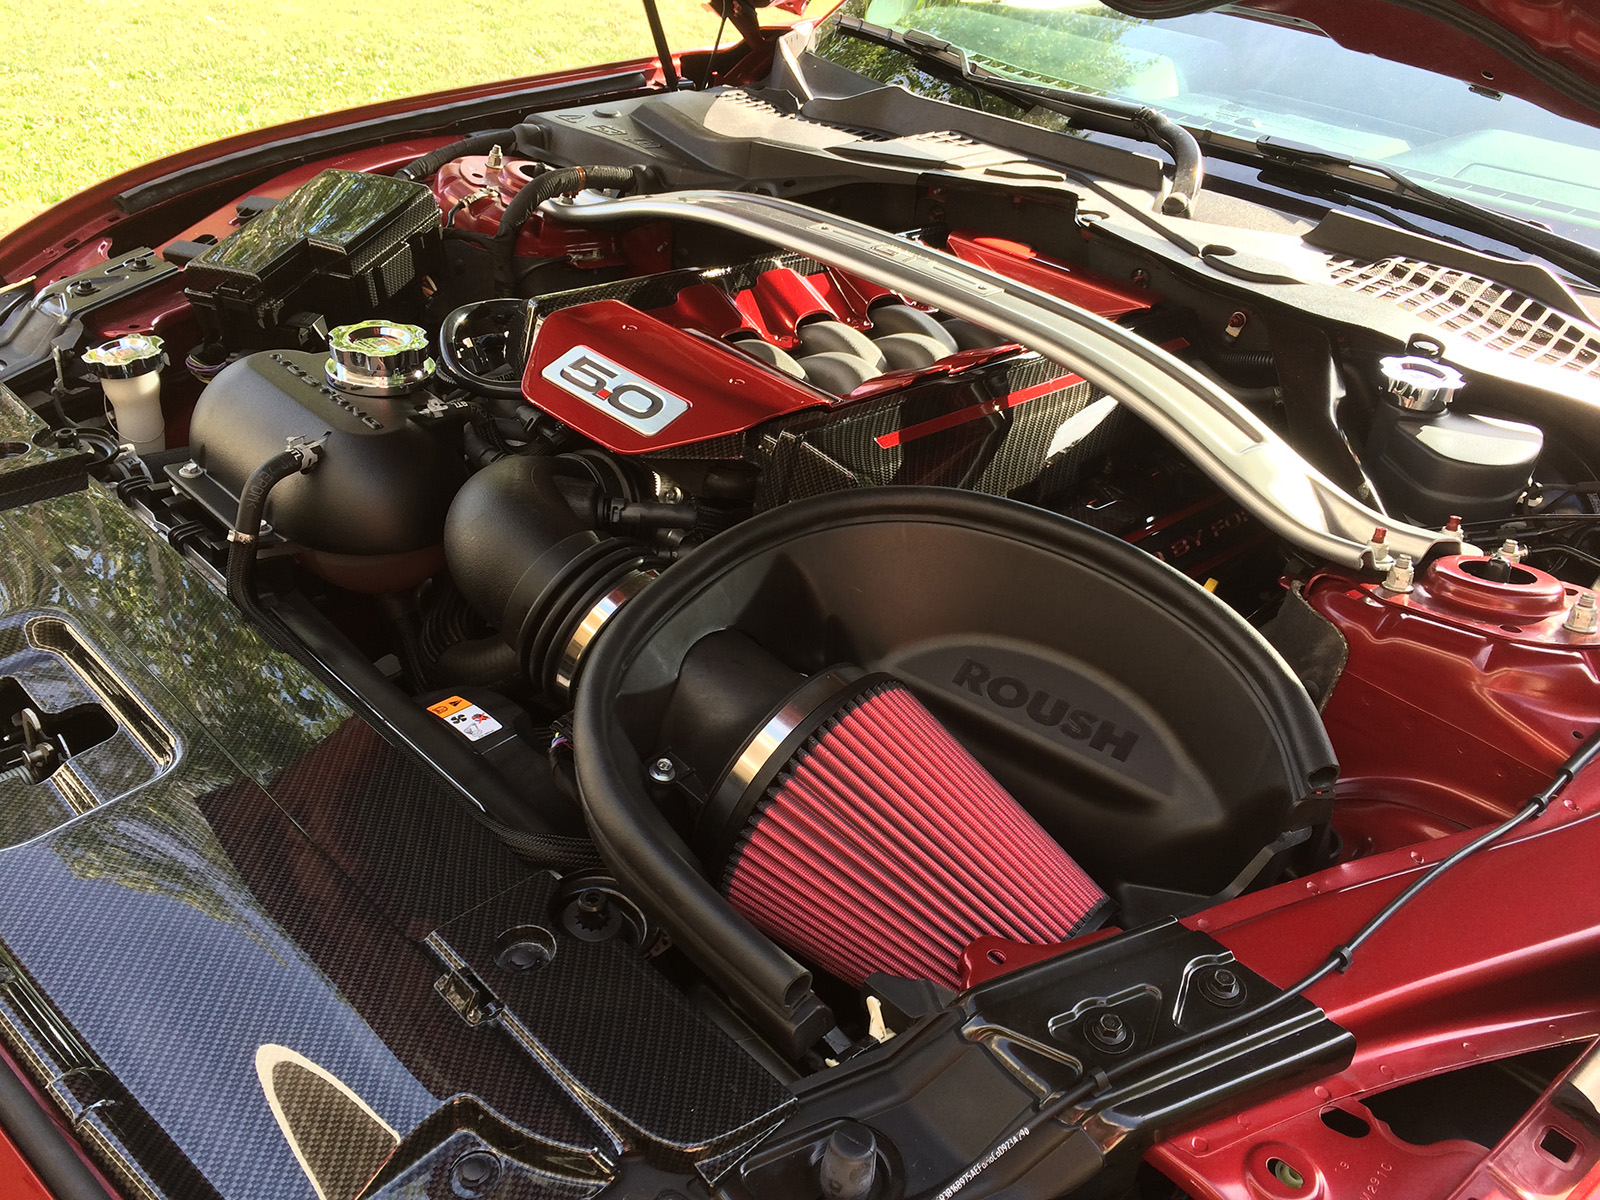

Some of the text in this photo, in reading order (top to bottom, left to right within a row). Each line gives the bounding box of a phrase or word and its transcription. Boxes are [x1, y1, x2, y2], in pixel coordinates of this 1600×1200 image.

[560, 356, 664, 420] 5.0
[1171, 529, 1203, 557] BY
[952, 658, 1140, 763] ROUSH
